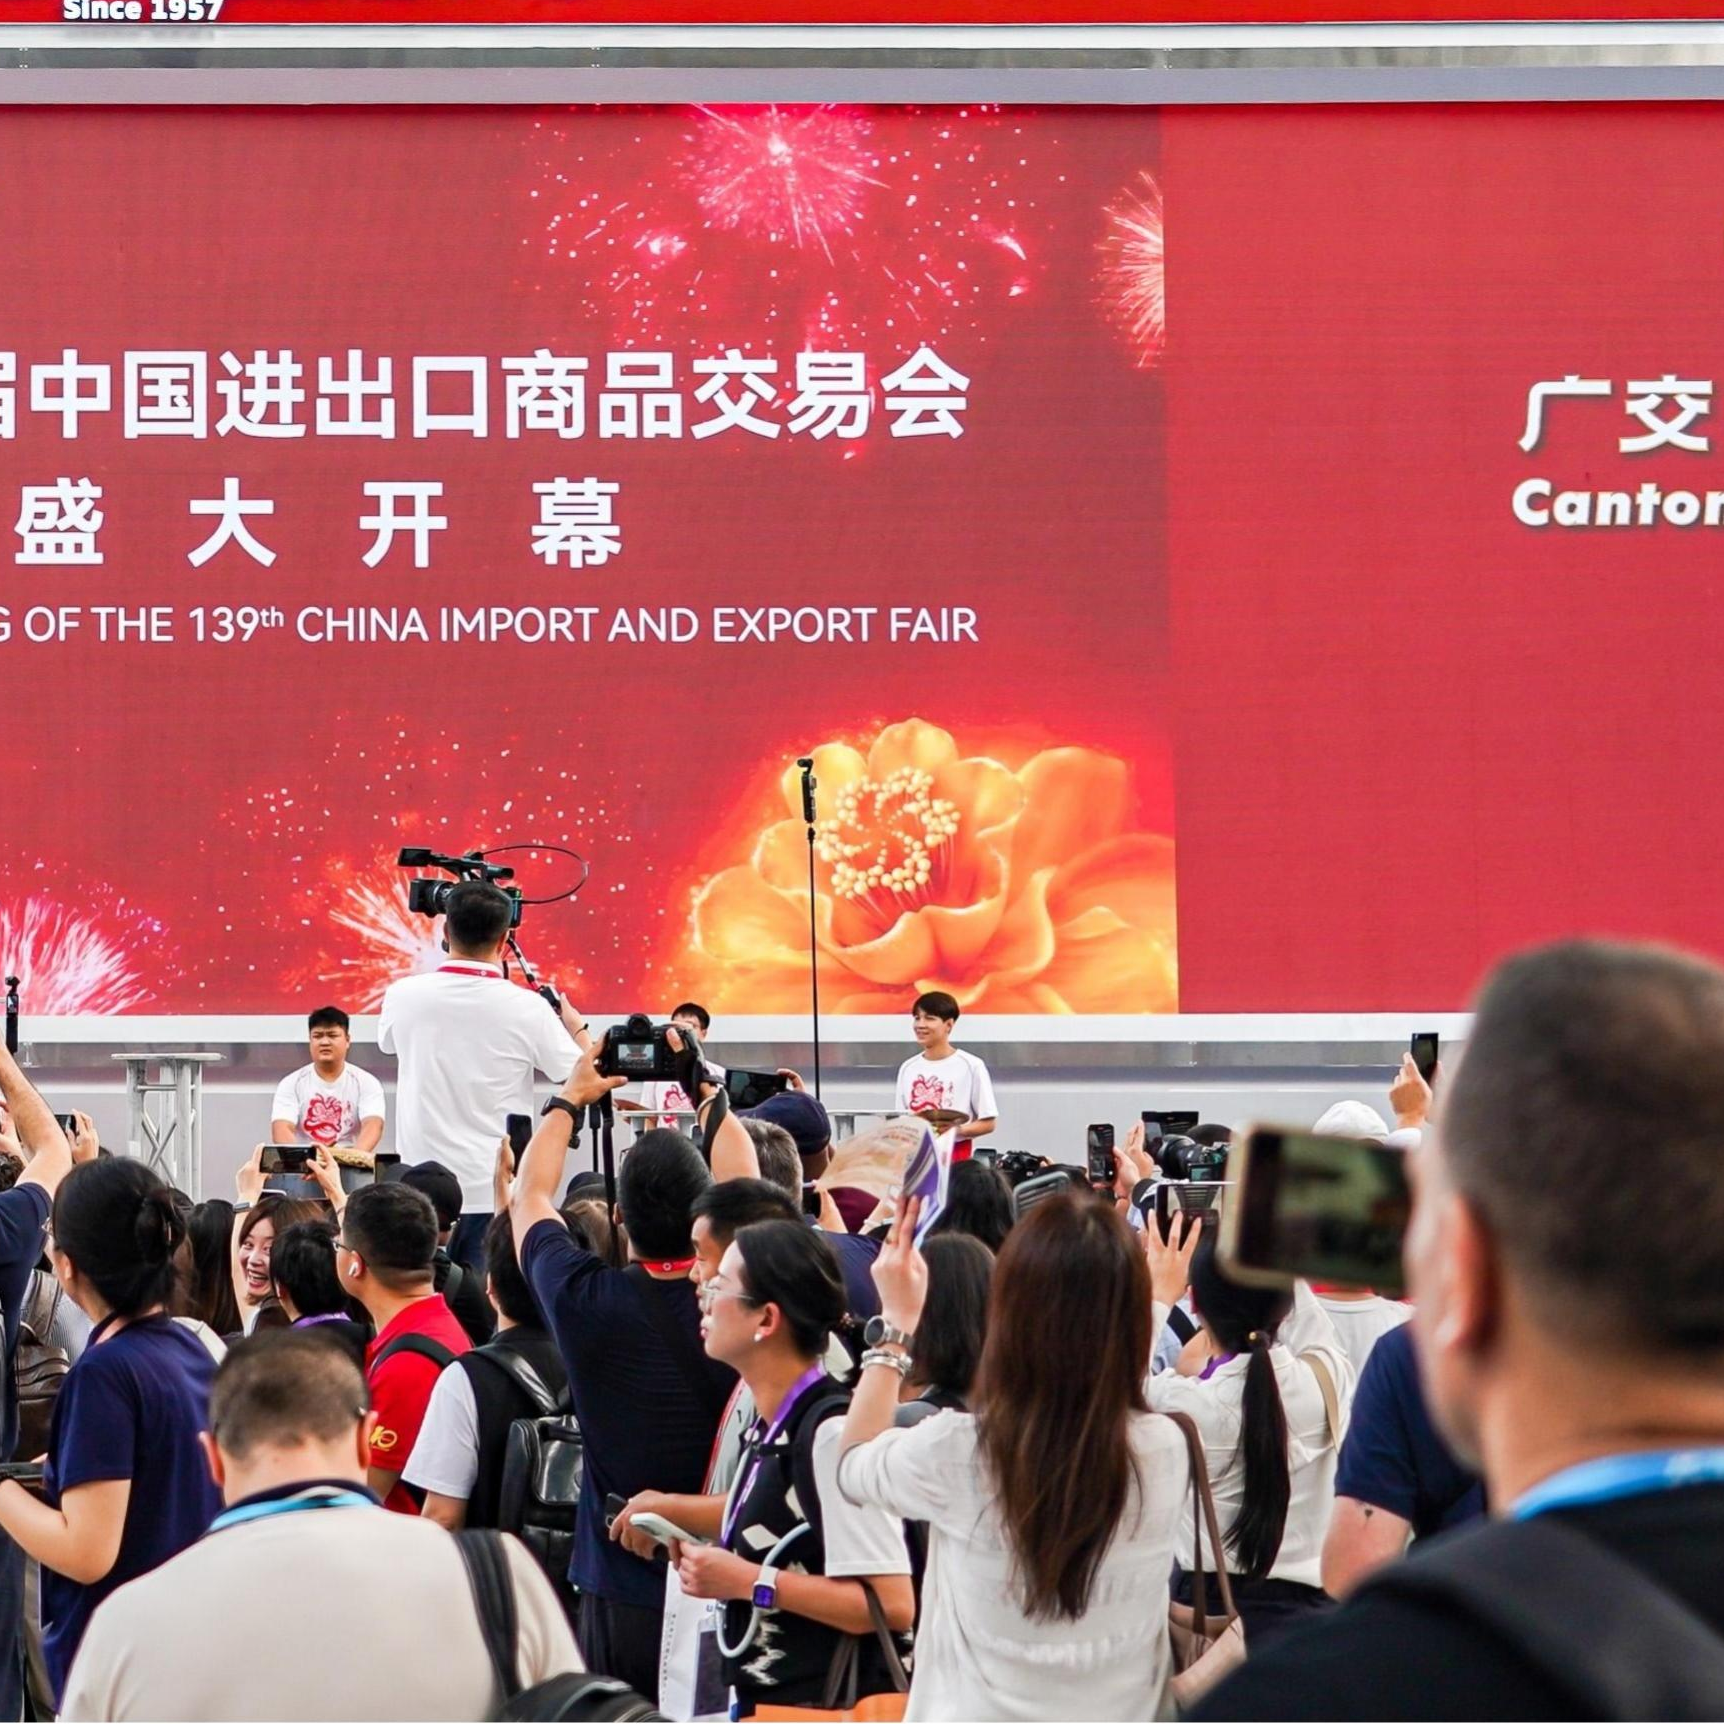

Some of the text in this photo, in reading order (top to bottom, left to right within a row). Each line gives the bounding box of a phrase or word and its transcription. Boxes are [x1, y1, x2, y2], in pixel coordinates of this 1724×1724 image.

[1518, 374, 1713, 453] 广交
[24, 606, 82, 642] OF
[90, 606, 174, 642] THE
[296, 606, 429, 642] CHINA
[440, 606, 600, 642] IMPORT
[607, 606, 699, 642] AND
[713, 606, 878, 642] EXPORT
[890, 606, 979, 642] FAIR
